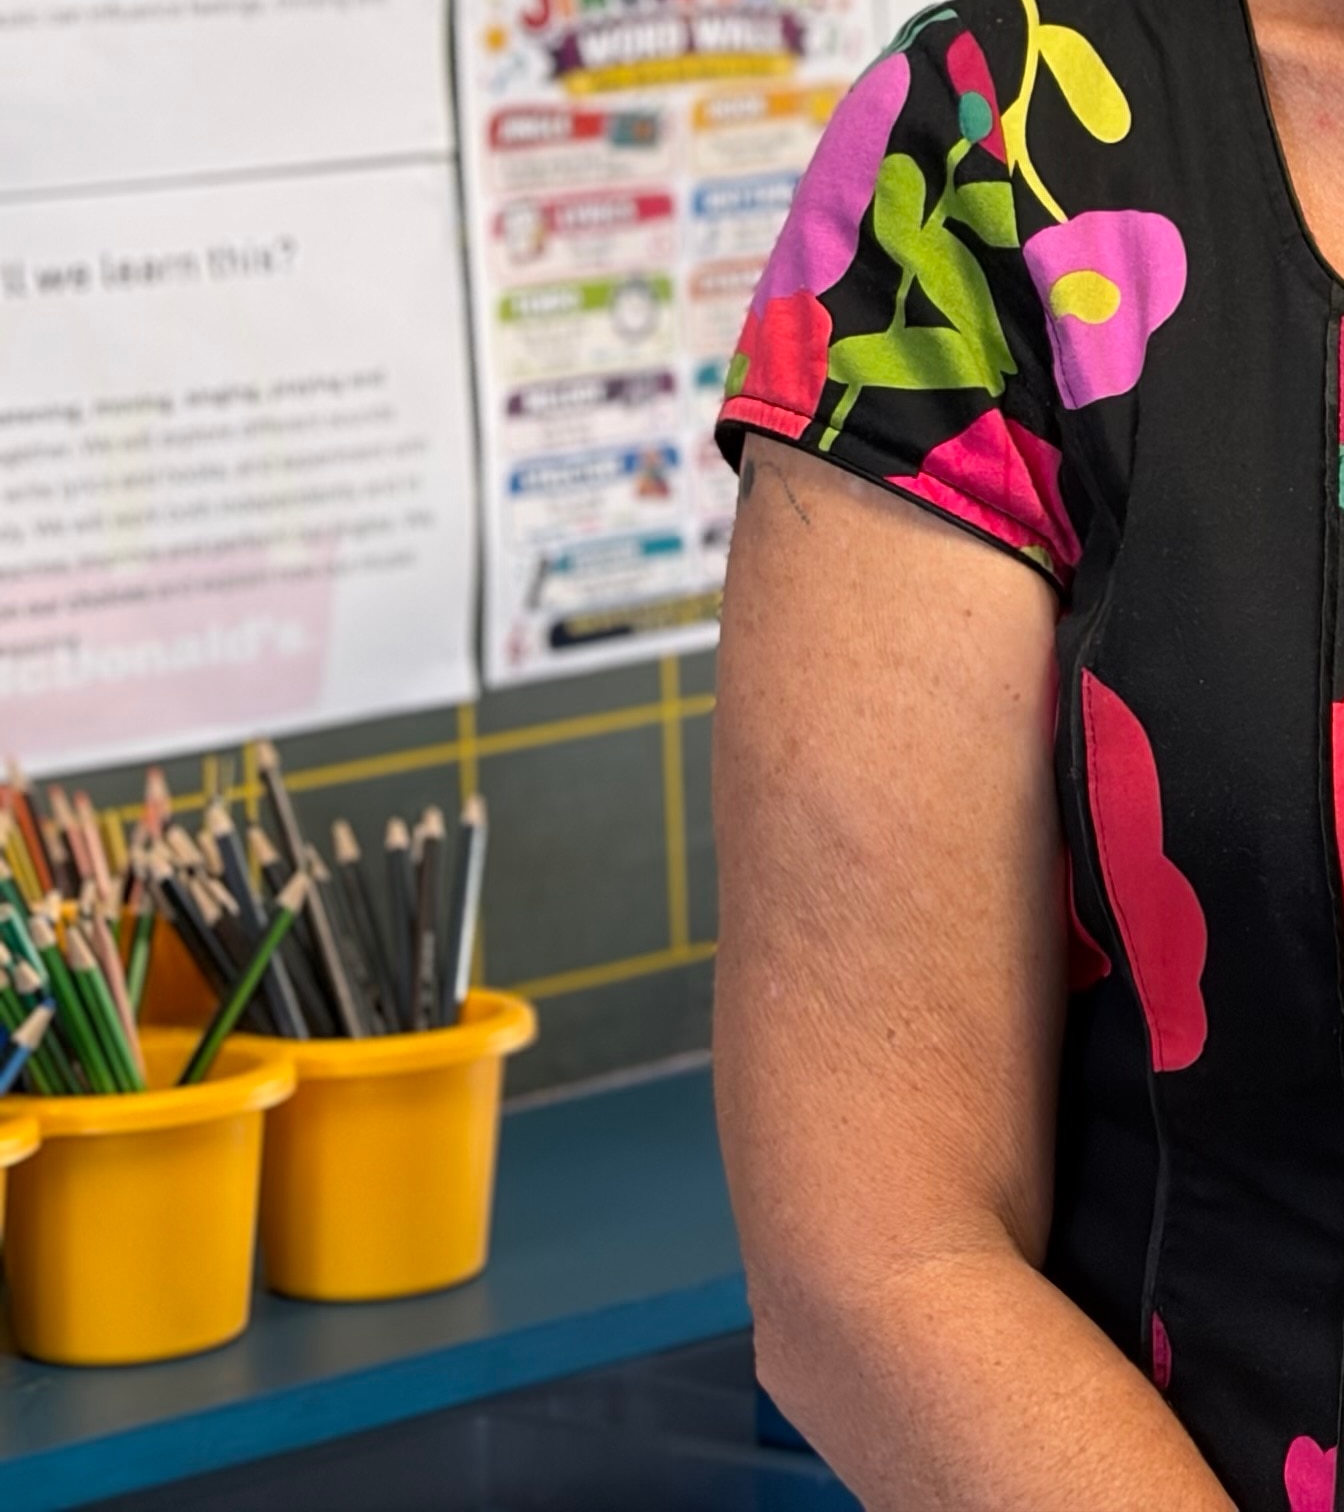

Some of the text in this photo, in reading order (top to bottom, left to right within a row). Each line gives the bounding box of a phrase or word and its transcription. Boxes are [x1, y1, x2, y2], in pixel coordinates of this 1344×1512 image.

[582, 15, 784, 65] WORD WALL
[100, 247, 201, 291] learn
